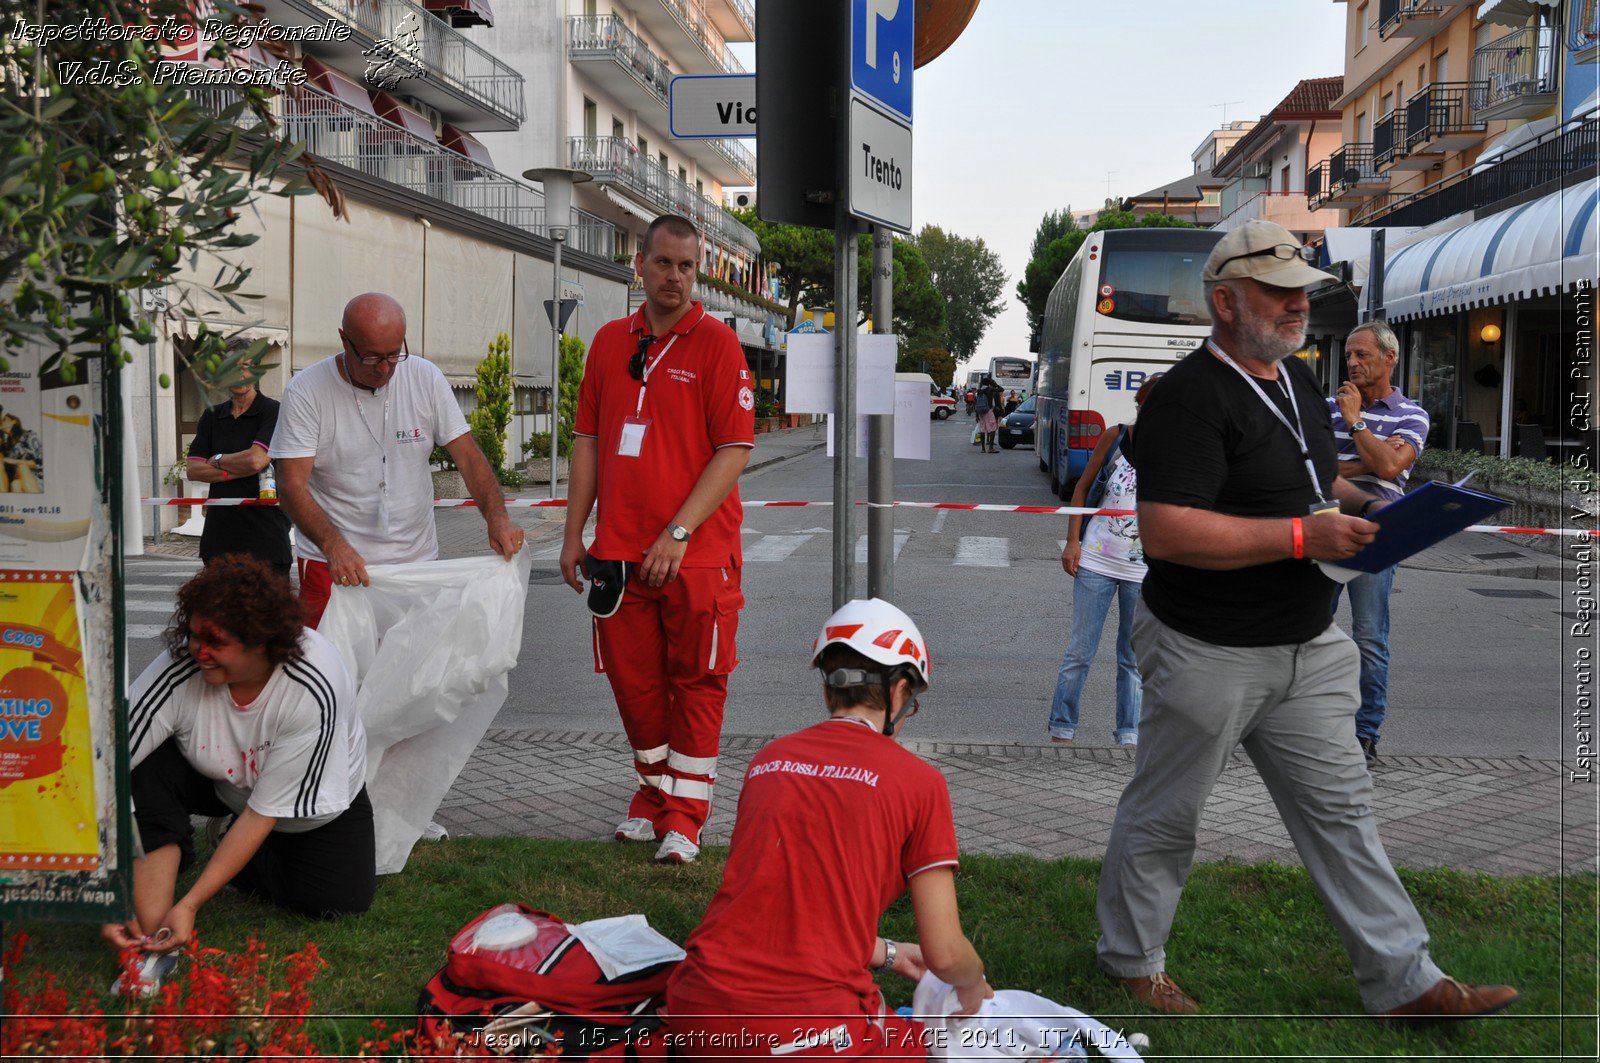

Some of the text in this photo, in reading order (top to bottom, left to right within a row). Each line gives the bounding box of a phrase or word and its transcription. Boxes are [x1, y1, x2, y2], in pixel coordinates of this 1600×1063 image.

[892, 50, 901, 84] 9
[862, 142, 902, 191] Trento
[1101, 300, 1110, 310] 80
[1167, 339, 1197, 347] MAN
[396, 429, 421, 439] FACE
[3, 629, 44, 648] CROS
[748, 760, 879, 787] CROCE ROSSA ITALIANA
